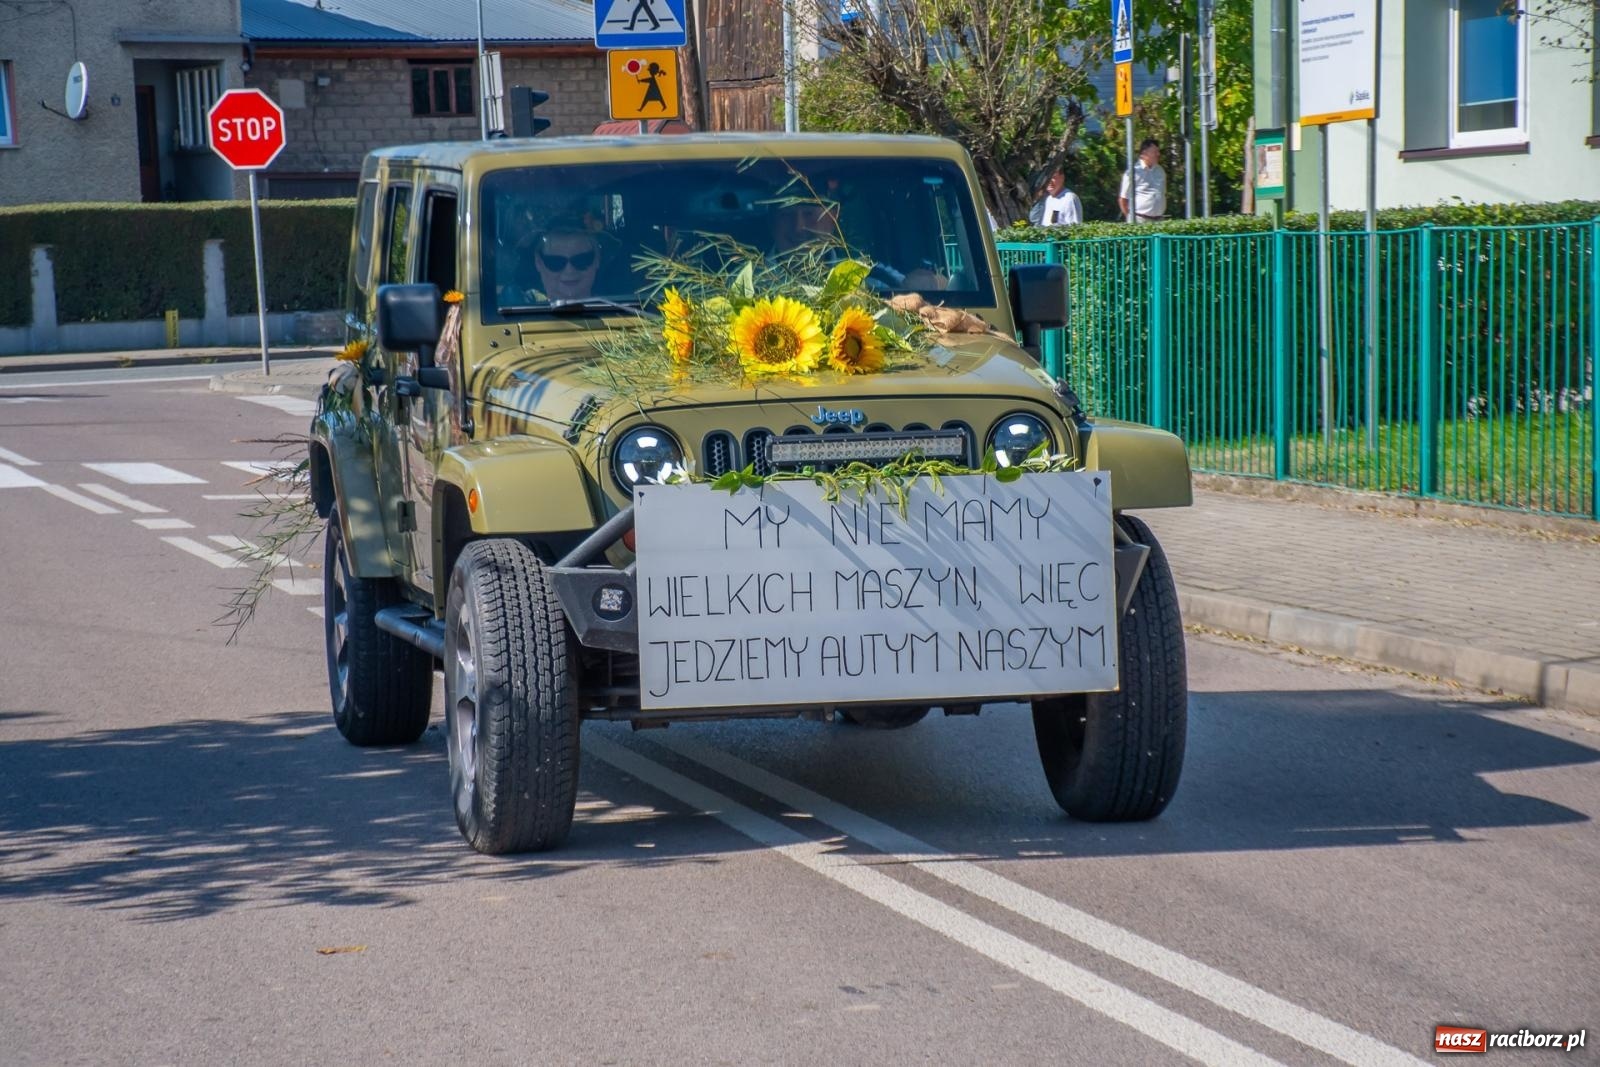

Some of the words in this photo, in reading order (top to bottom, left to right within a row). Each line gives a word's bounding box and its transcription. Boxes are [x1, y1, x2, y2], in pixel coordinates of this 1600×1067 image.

[217, 116, 277, 142] STOP
[810, 404, 864, 425] Jeep
[724, 505, 791, 550] MY
[831, 501, 901, 546] NIE
[924, 497, 1051, 542] MAMY
[647, 571, 814, 618] WIELKICH
[834, 566, 983, 612] MASZYN,
[1018, 561, 1102, 610] WIĘC
[648, 635, 810, 698] JEDZIEMY
[820, 631, 940, 677] AUTYM
[957, 624, 1117, 673] NASZYM.
